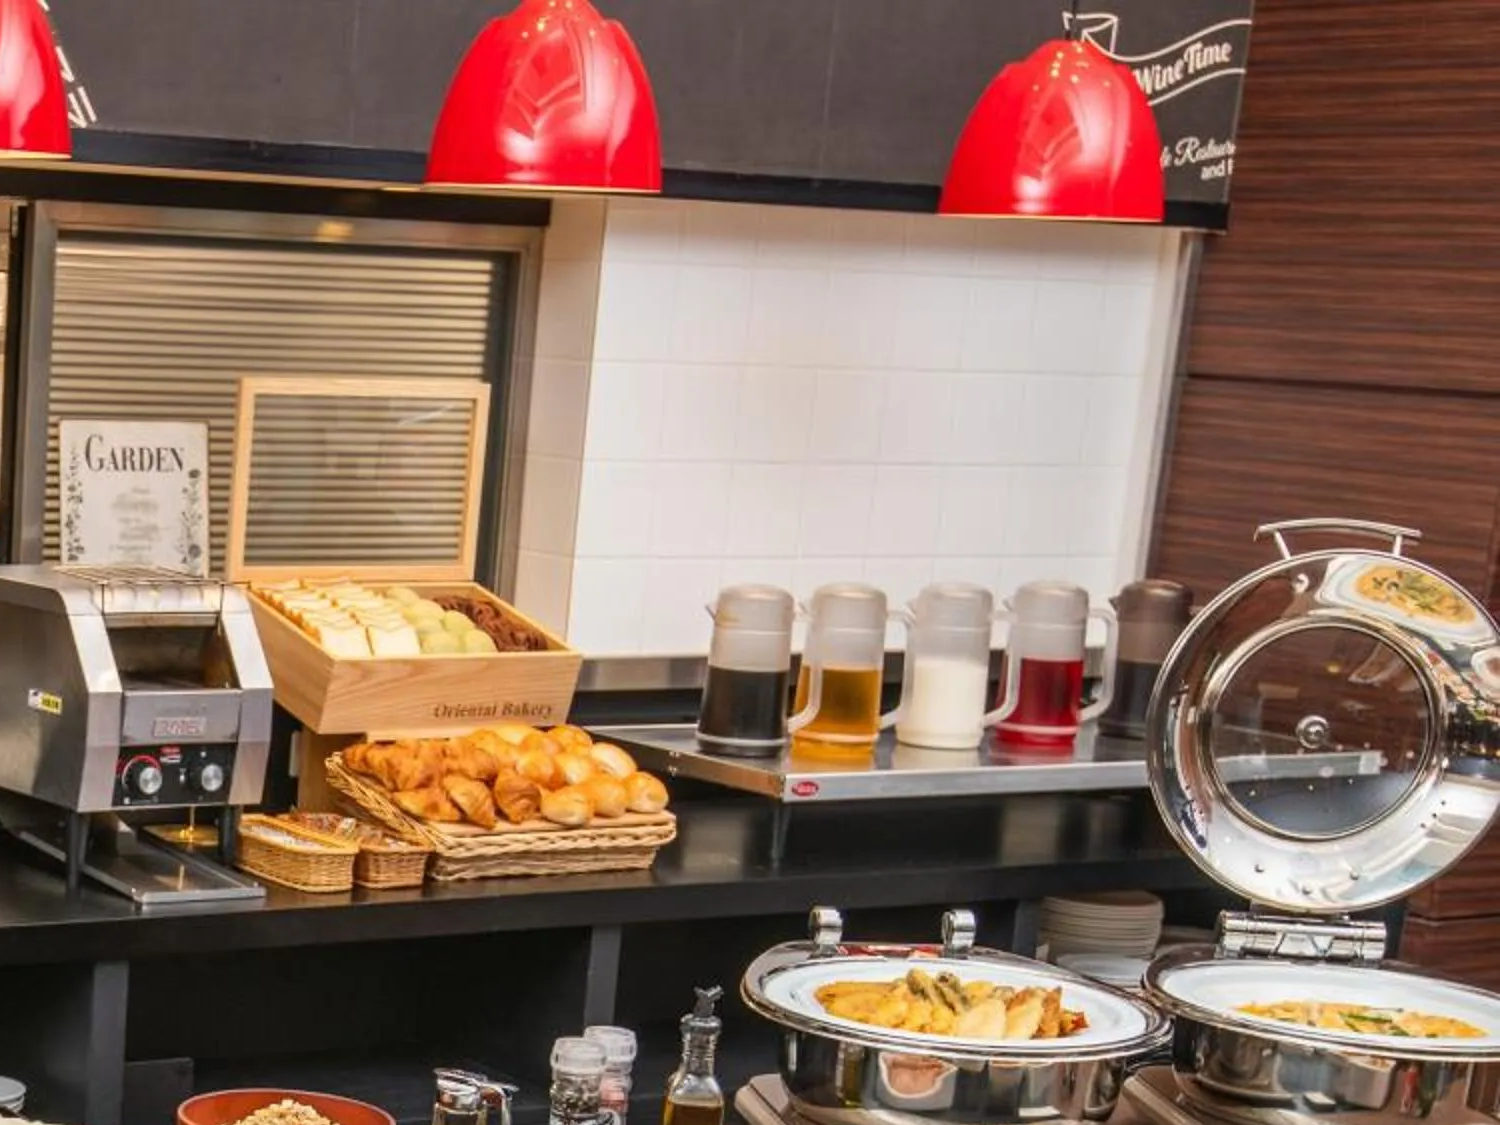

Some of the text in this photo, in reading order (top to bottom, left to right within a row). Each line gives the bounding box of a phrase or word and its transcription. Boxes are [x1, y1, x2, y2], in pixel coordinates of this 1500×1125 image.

[1133, 41, 1233, 94] Wine Time
[84, 433, 185, 473] GARDEN
